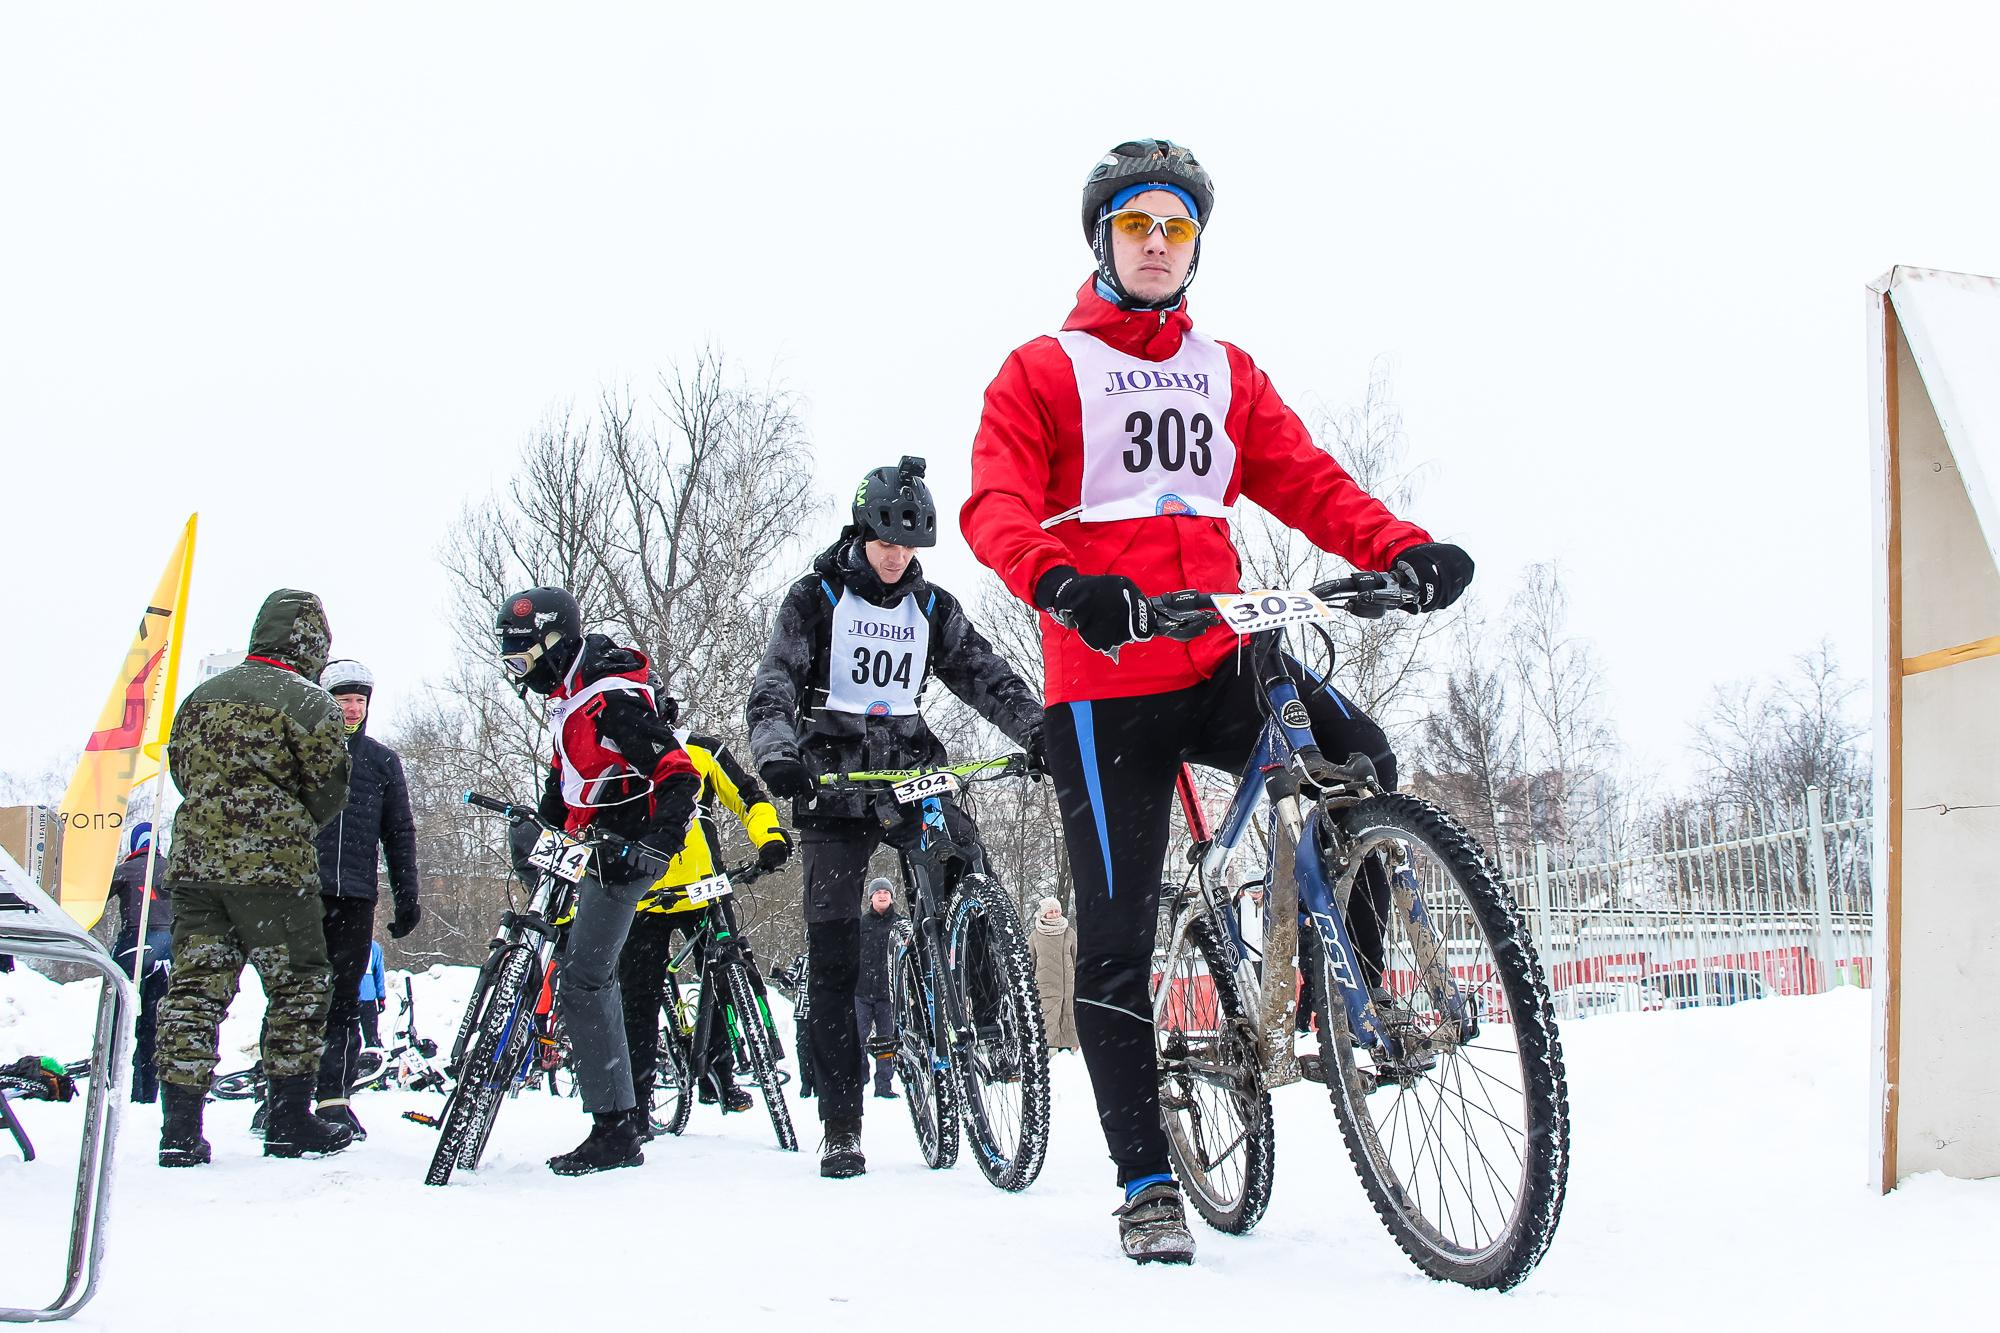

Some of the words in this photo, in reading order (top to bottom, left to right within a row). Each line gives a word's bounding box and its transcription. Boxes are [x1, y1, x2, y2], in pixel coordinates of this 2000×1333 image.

[1105, 371, 1210, 395] ЛОБНЯ
[1122, 408, 1213, 477] 303
[1232, 596, 1313, 622] 303
[848, 620, 915, 640] ЛОБНЯ
[852, 647, 912, 689] 304
[902, 775, 949, 797] 304
[540, 840, 584, 869] 314
[693, 880, 725, 898] 315
[1311, 911, 1358, 990] RST
